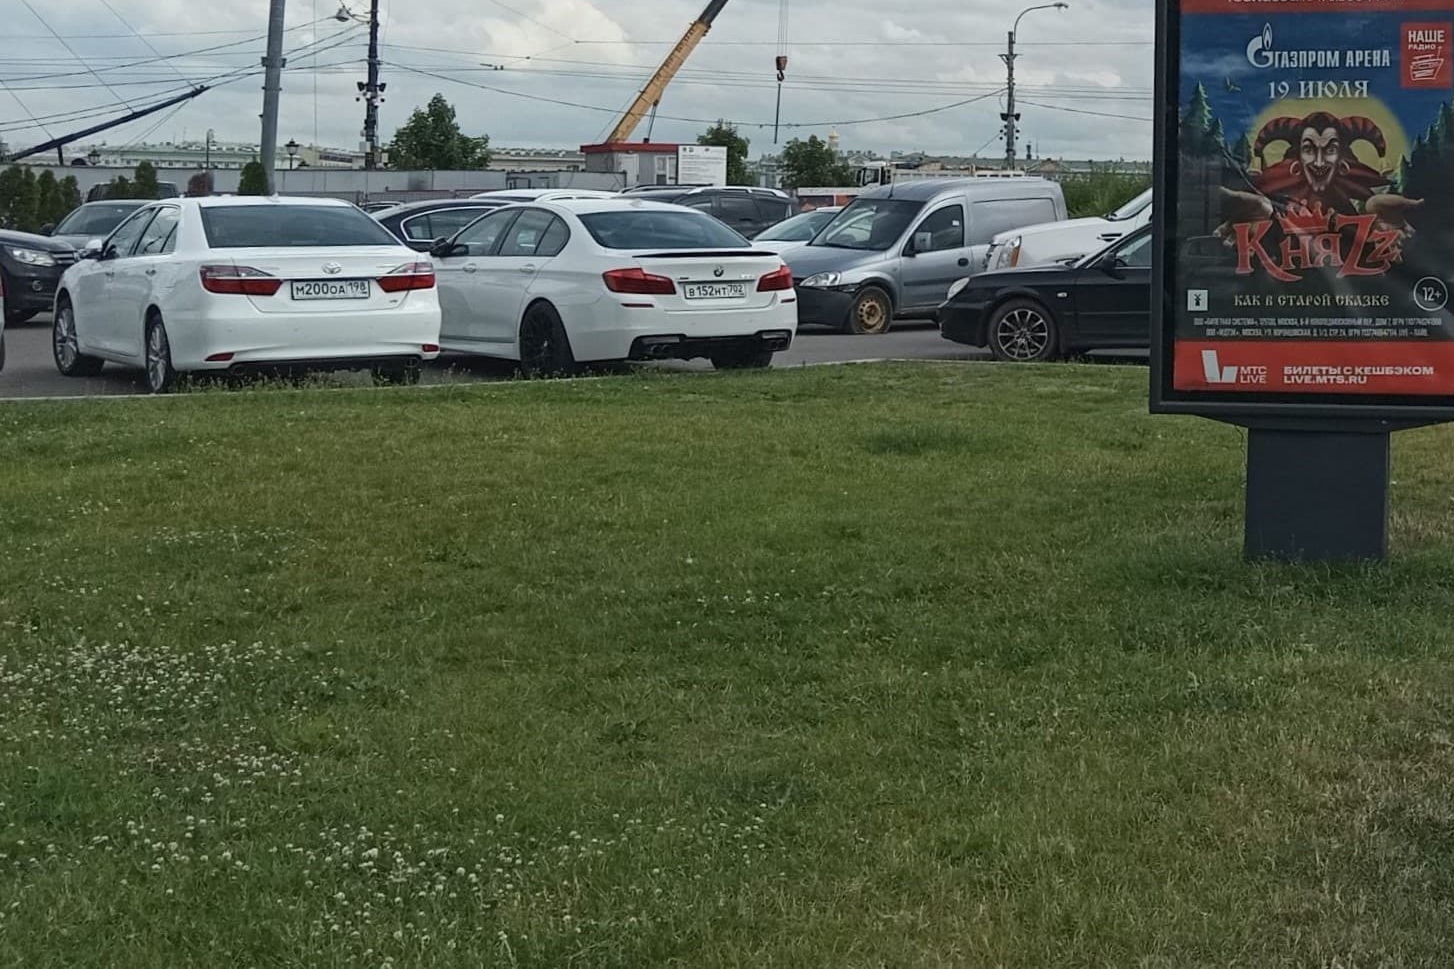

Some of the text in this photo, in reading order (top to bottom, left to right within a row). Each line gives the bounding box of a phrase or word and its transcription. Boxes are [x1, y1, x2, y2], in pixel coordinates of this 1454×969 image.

[1408, 30, 1445, 43] НАШЕ
[1275, 49, 1391, 68] ГАЗПРОМ АРЕНА
[1268, 80, 1370, 99] 19 ИЮЛЯ
[1234, 293, 1390, 307] КАК В СТАРОЙ СКАЗКЕ
[1422, 286, 1442, 302] 12+
[1240, 365, 1267, 375] МТС
[1283, 366, 1434, 375] БИЛЕТЫ С КЕШБЭКОМ
[1240, 374, 1267, 384] LIVE
[1283, 375, 1367, 384] LIVE.MTS.RU
